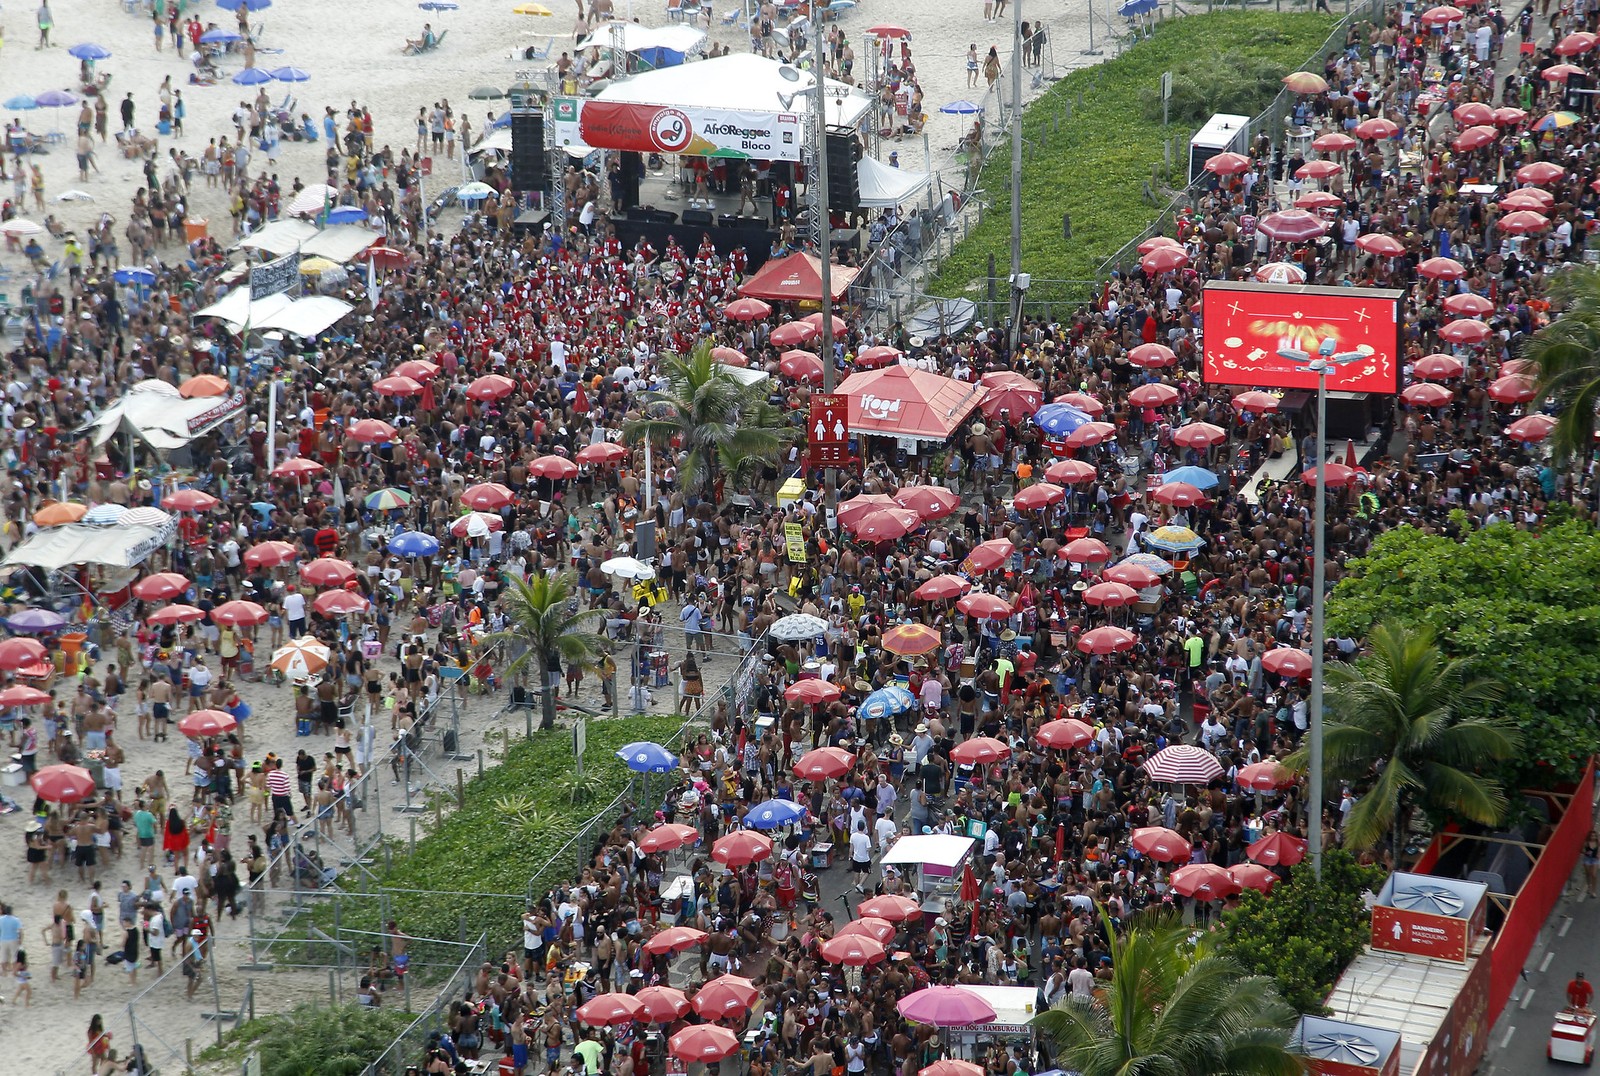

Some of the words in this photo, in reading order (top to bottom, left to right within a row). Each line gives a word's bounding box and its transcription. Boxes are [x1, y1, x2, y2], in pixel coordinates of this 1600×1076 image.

[741, 140, 771, 150] Bloco
[1412, 924, 1445, 934] BANHEIRO
[1412, 931, 1448, 941] MASCULINO
